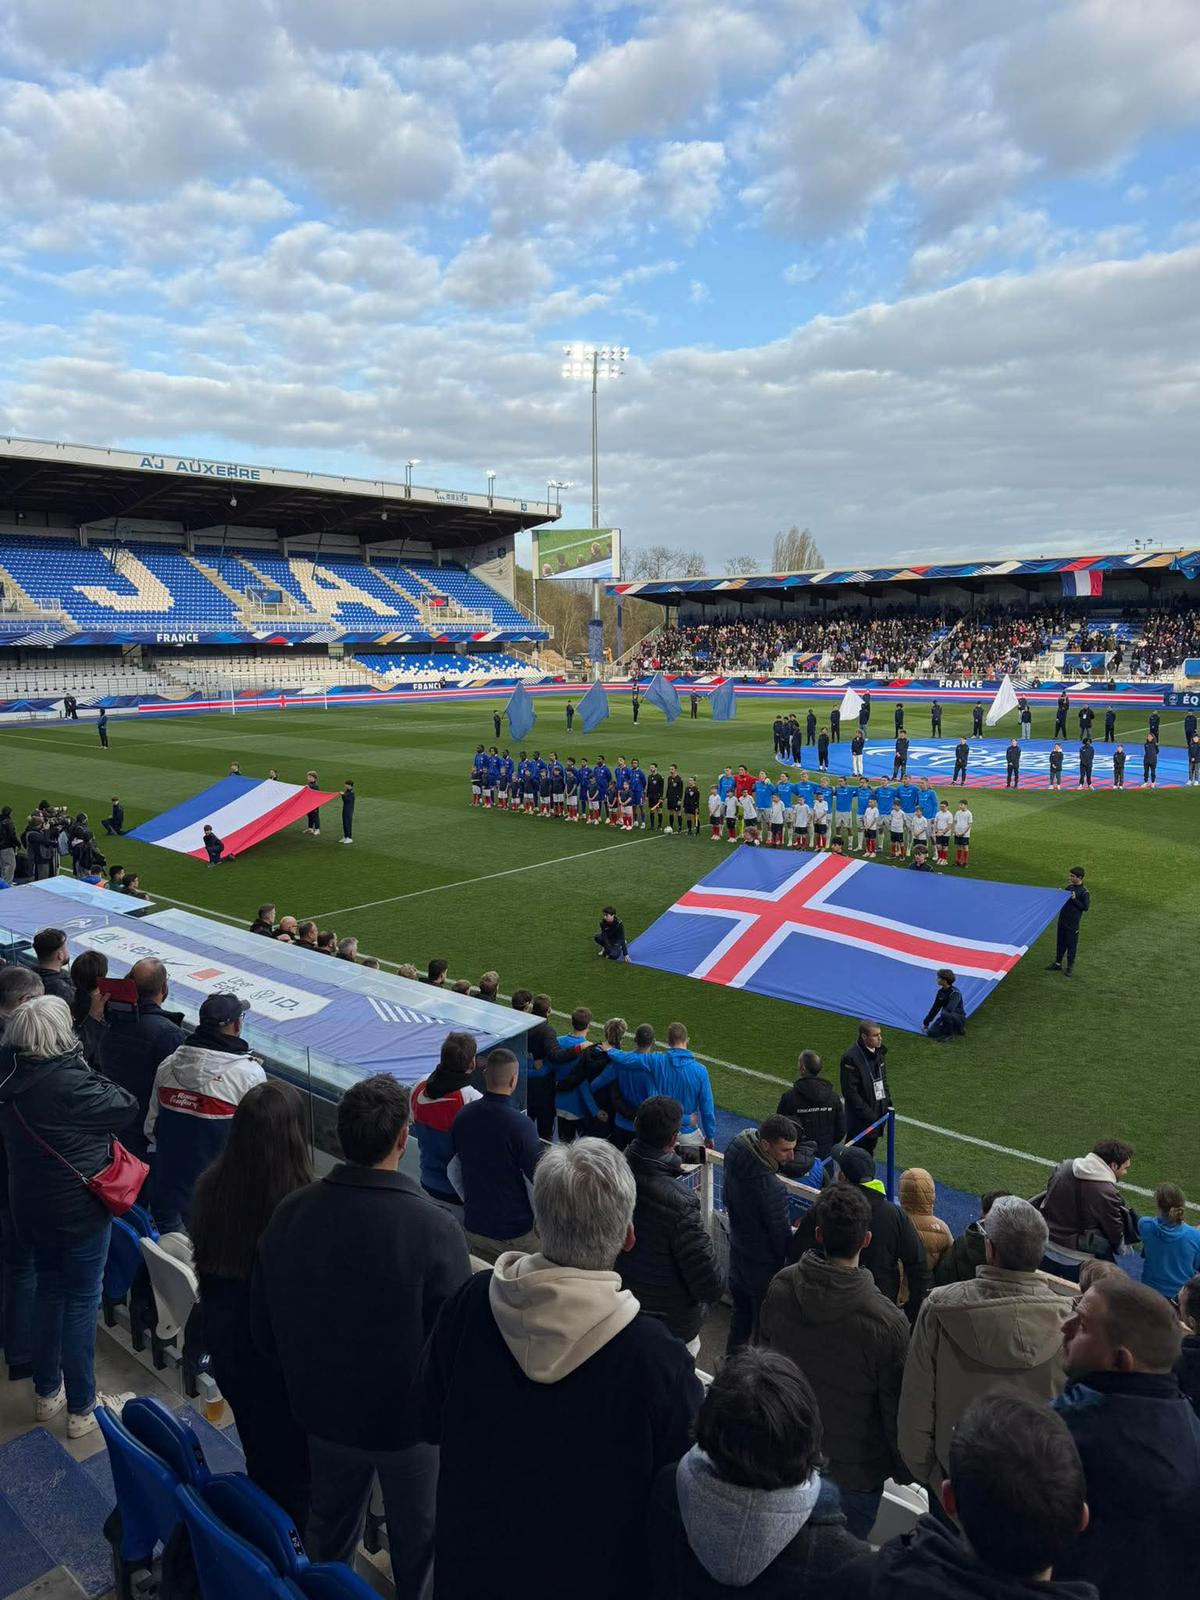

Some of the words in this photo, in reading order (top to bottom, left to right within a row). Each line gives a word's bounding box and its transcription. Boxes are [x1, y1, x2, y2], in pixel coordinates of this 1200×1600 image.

[140, 457, 164, 470] AJ
[176, 460, 261, 480] AUXERRE
[156, 633, 200, 643] FRANCE
[938, 680, 984, 689] FRANCE
